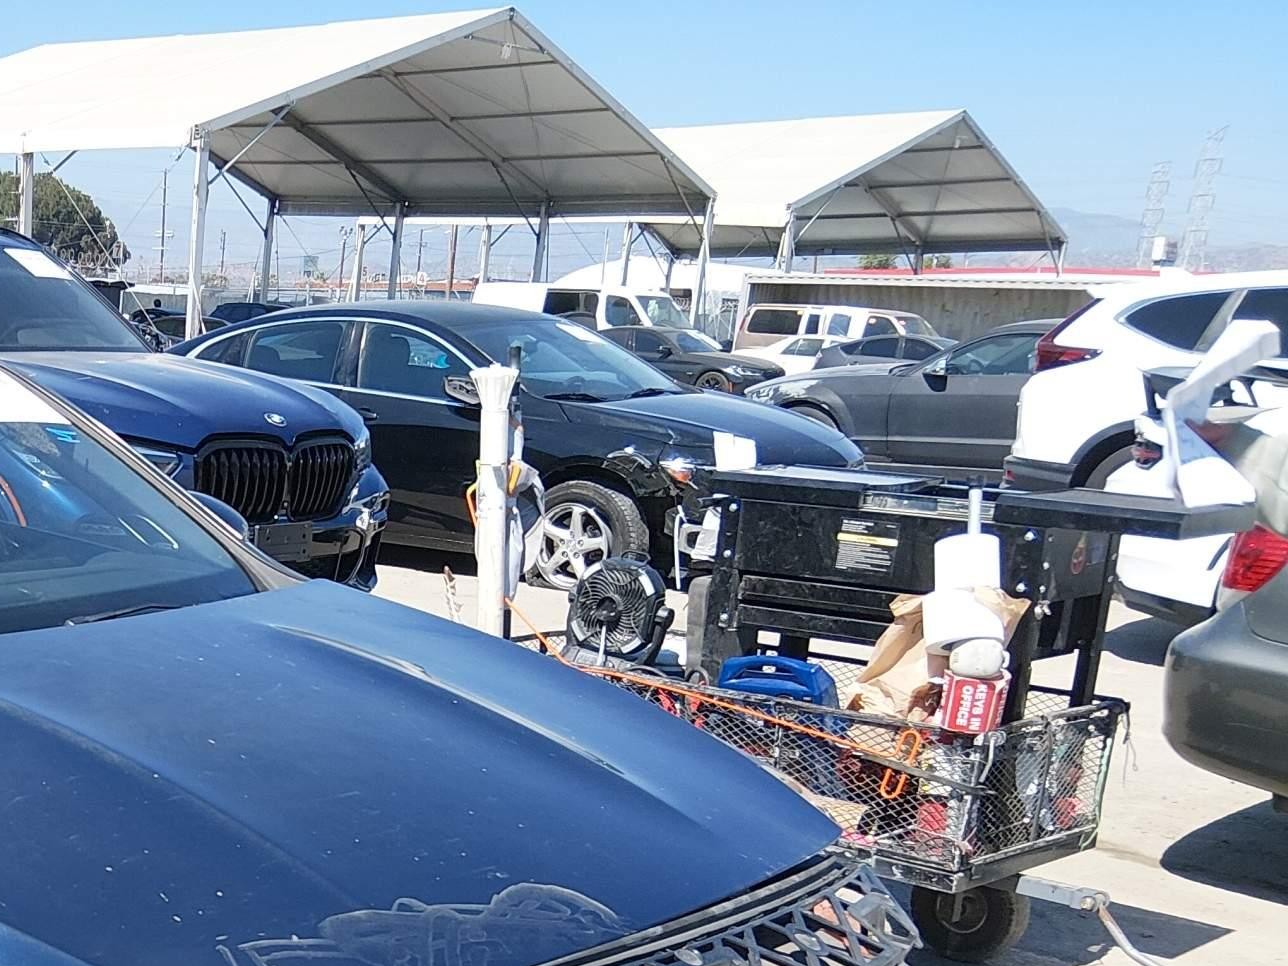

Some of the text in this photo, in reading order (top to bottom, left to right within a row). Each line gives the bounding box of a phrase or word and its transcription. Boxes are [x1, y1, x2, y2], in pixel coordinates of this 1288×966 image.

[955, 685, 974, 726] OFFICE
[968, 683, 988, 731] KEYS IN
